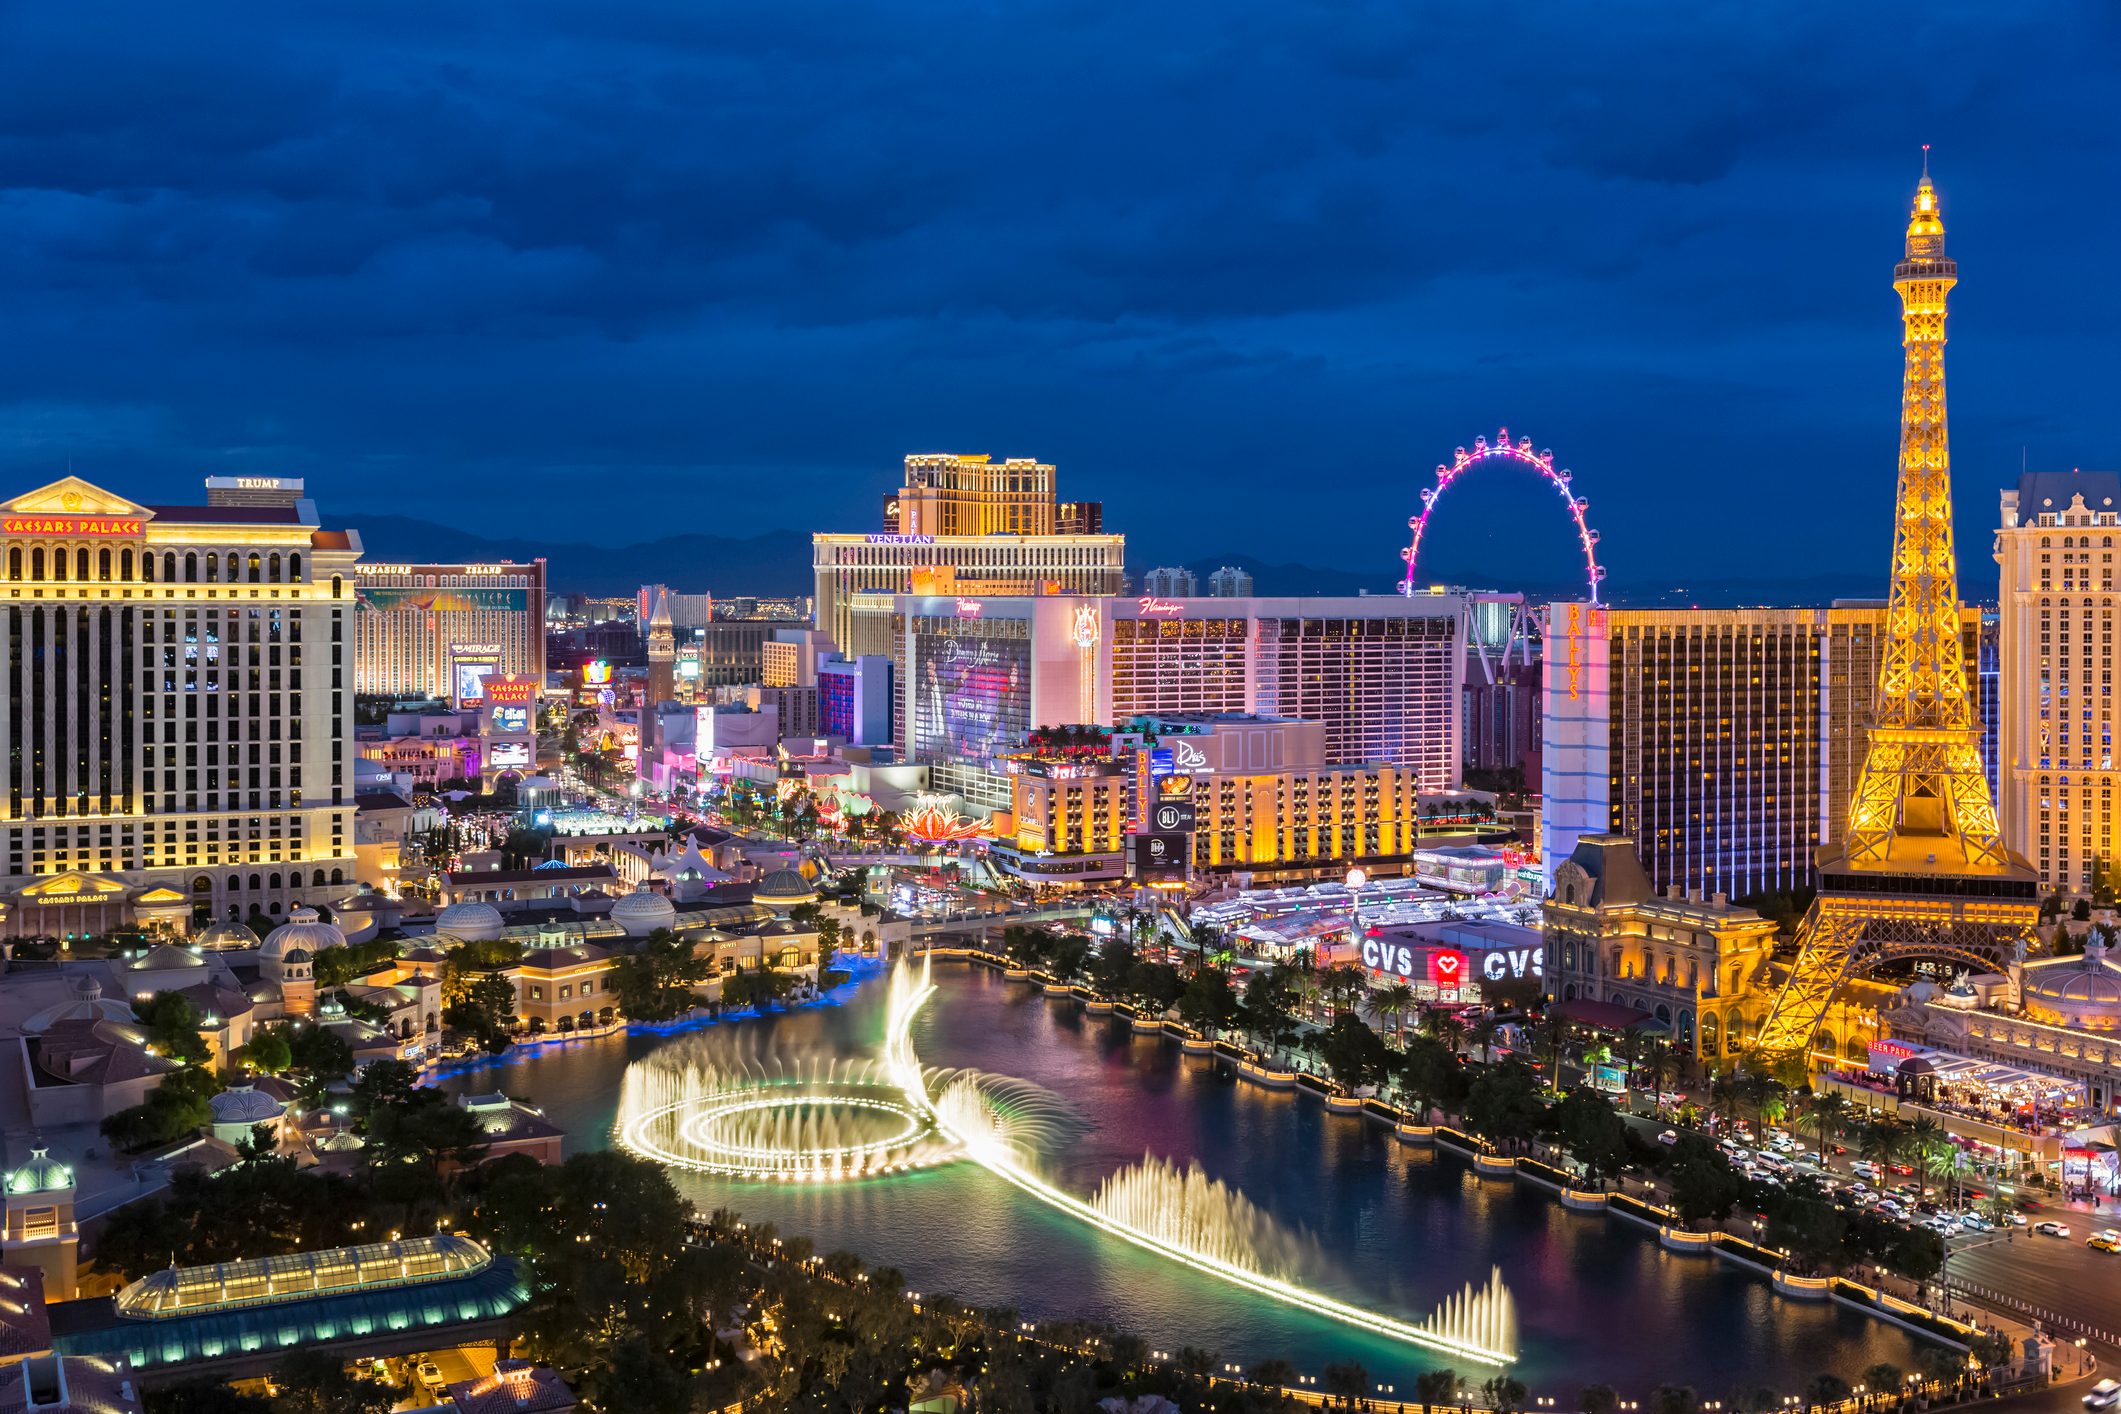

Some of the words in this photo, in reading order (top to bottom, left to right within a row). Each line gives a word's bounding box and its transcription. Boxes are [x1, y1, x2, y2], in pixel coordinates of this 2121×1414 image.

[237, 479, 280, 488] TRUMP
[3, 520, 74, 533] CAESARS
[80, 521, 140, 533] PALACE
[868, 535, 931, 543] VENETIAN
[355, 566, 412, 574] TREASURE
[465, 566, 502, 574] ISLAND
[1138, 597, 1184, 615] Flamingo
[1567, 604, 1581, 700] BALLYS
[490, 684, 530, 693] CAESARS
[492, 692, 528, 701] PALACE
[505, 708, 526, 720] elton
[1137, 752, 1148, 824] BALLYS
[1162, 811, 1175, 824] BLT
[38, 895, 74, 904] CAESARS
[1363, 939, 1412, 976] CVS
[1484, 947, 1543, 981] CVS
[1868, 1041, 1888, 1052] BEER
[1890, 1046, 1912, 1057] PARK
